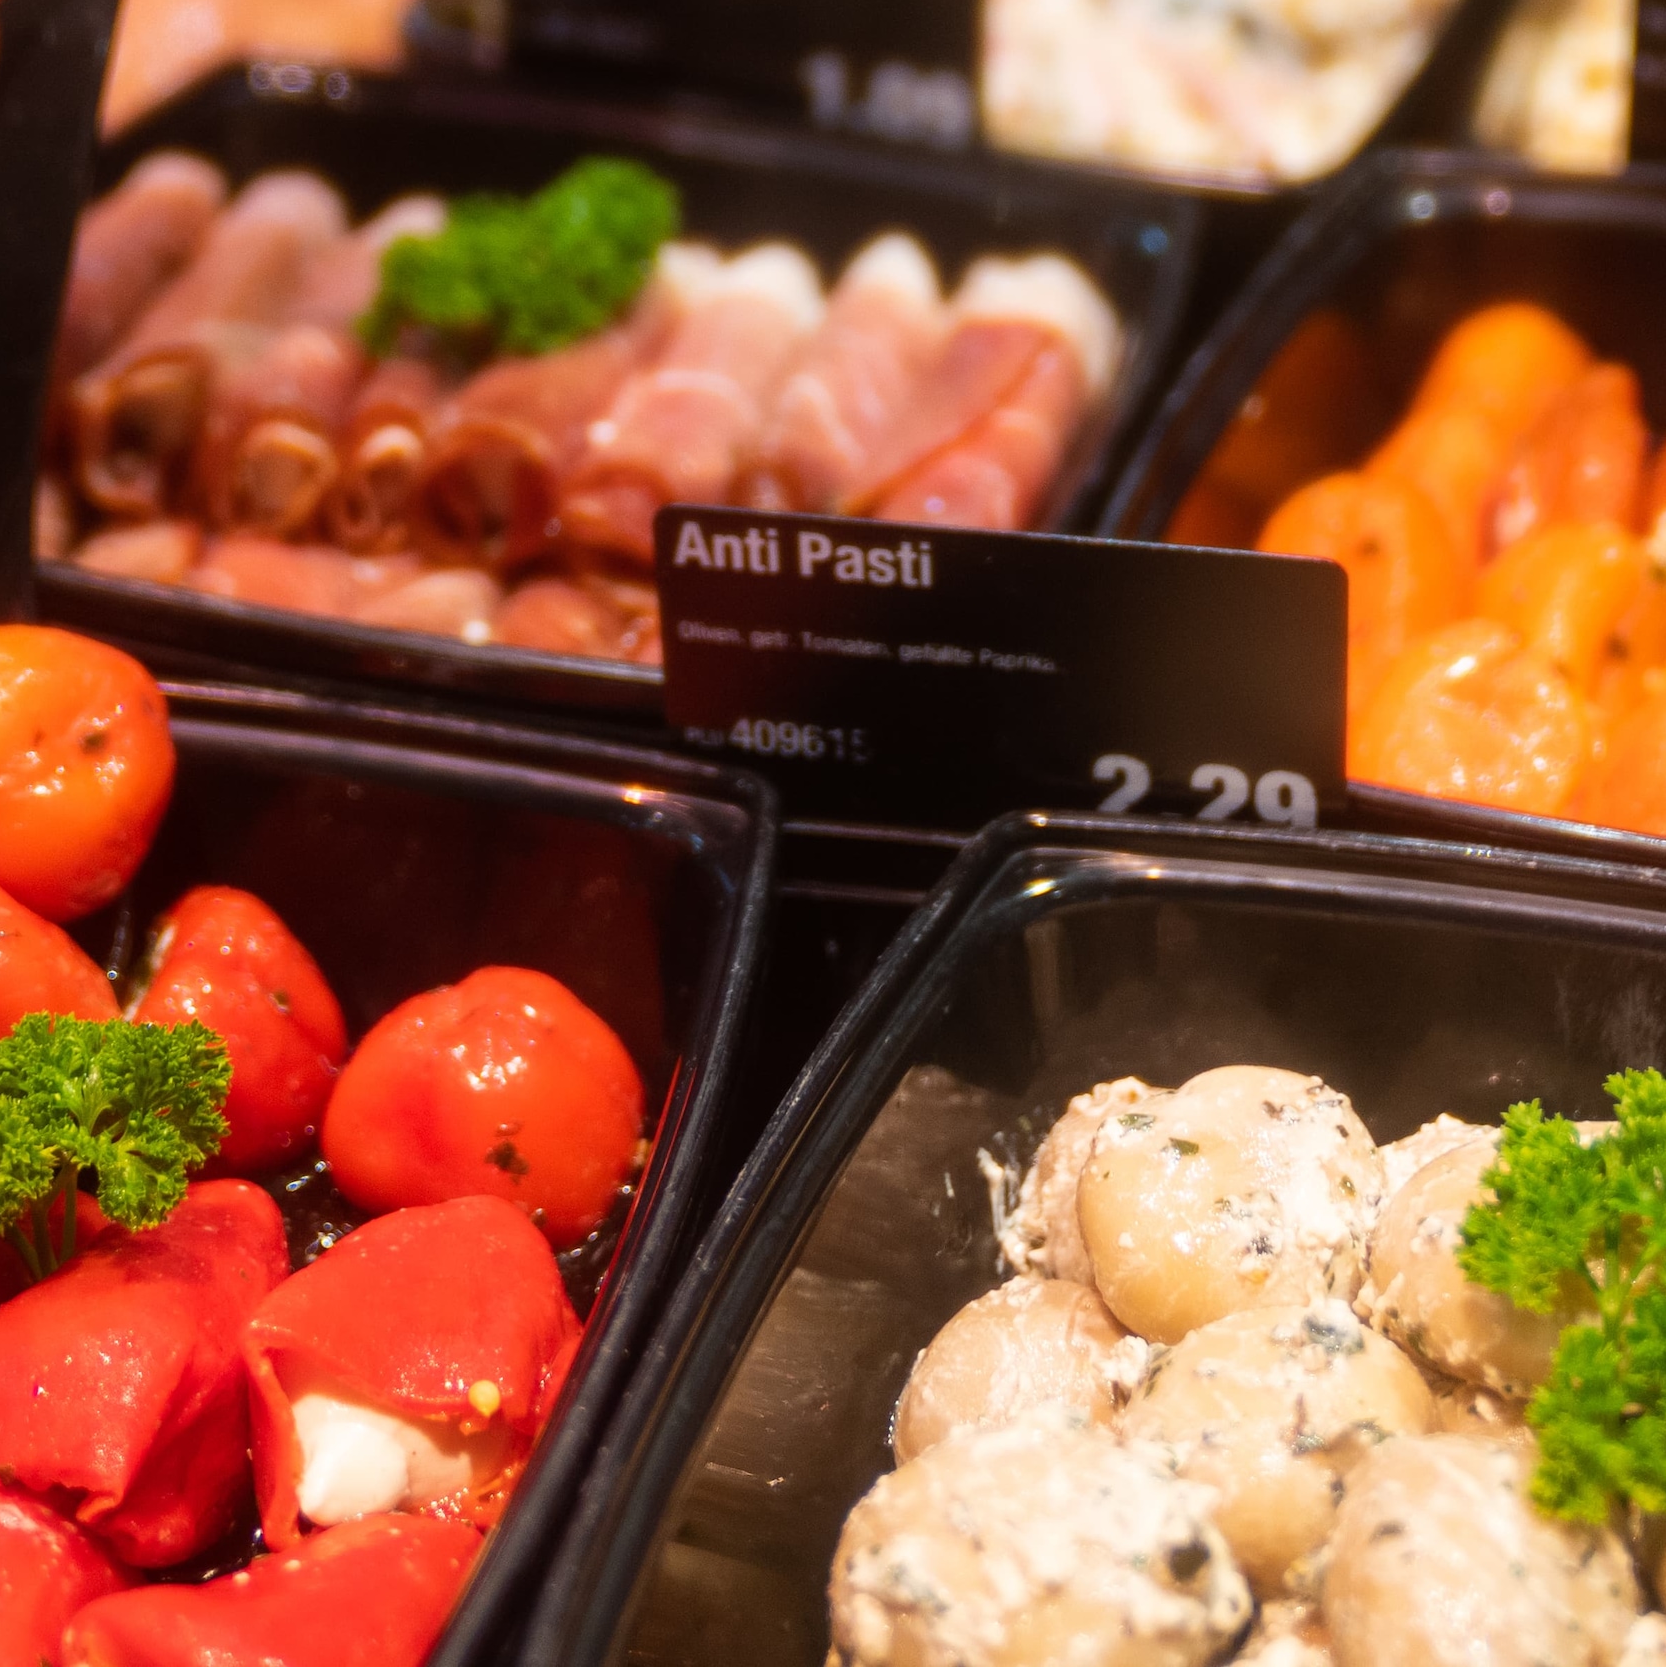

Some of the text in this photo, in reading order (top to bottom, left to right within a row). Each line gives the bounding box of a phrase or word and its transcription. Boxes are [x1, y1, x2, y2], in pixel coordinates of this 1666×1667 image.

[674, 521, 934, 589] Anti Pasti
[1091, 752, 1319, 831] 229
